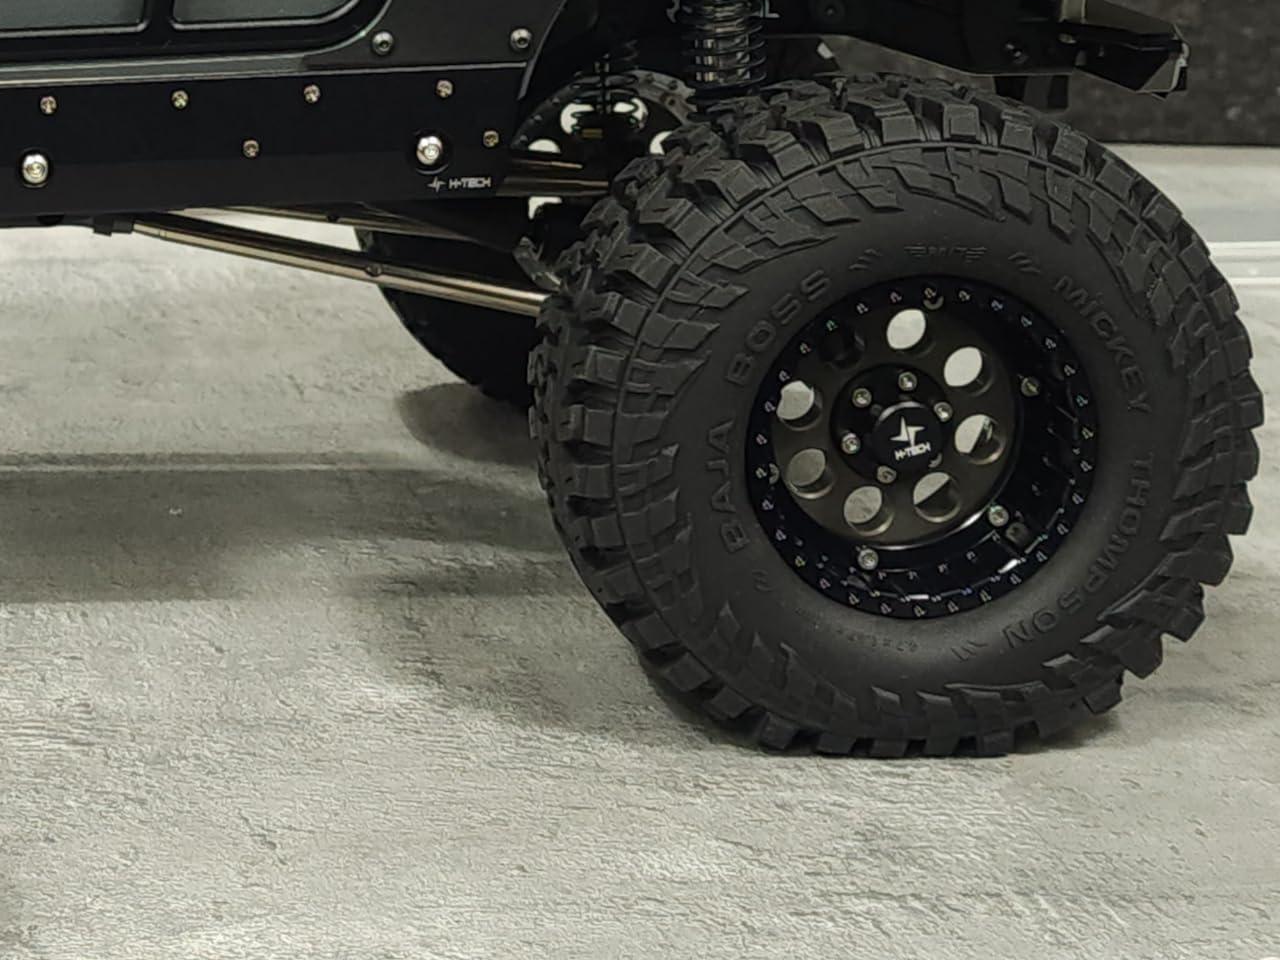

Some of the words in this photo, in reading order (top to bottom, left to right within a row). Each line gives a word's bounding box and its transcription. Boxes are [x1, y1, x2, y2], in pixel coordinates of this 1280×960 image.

[726, 268, 831, 386] BOSS
[1053, 274, 1152, 414] MICKEY
[706, 419, 750, 554] BAJA
[1003, 452, 1153, 649] THOMPSON
